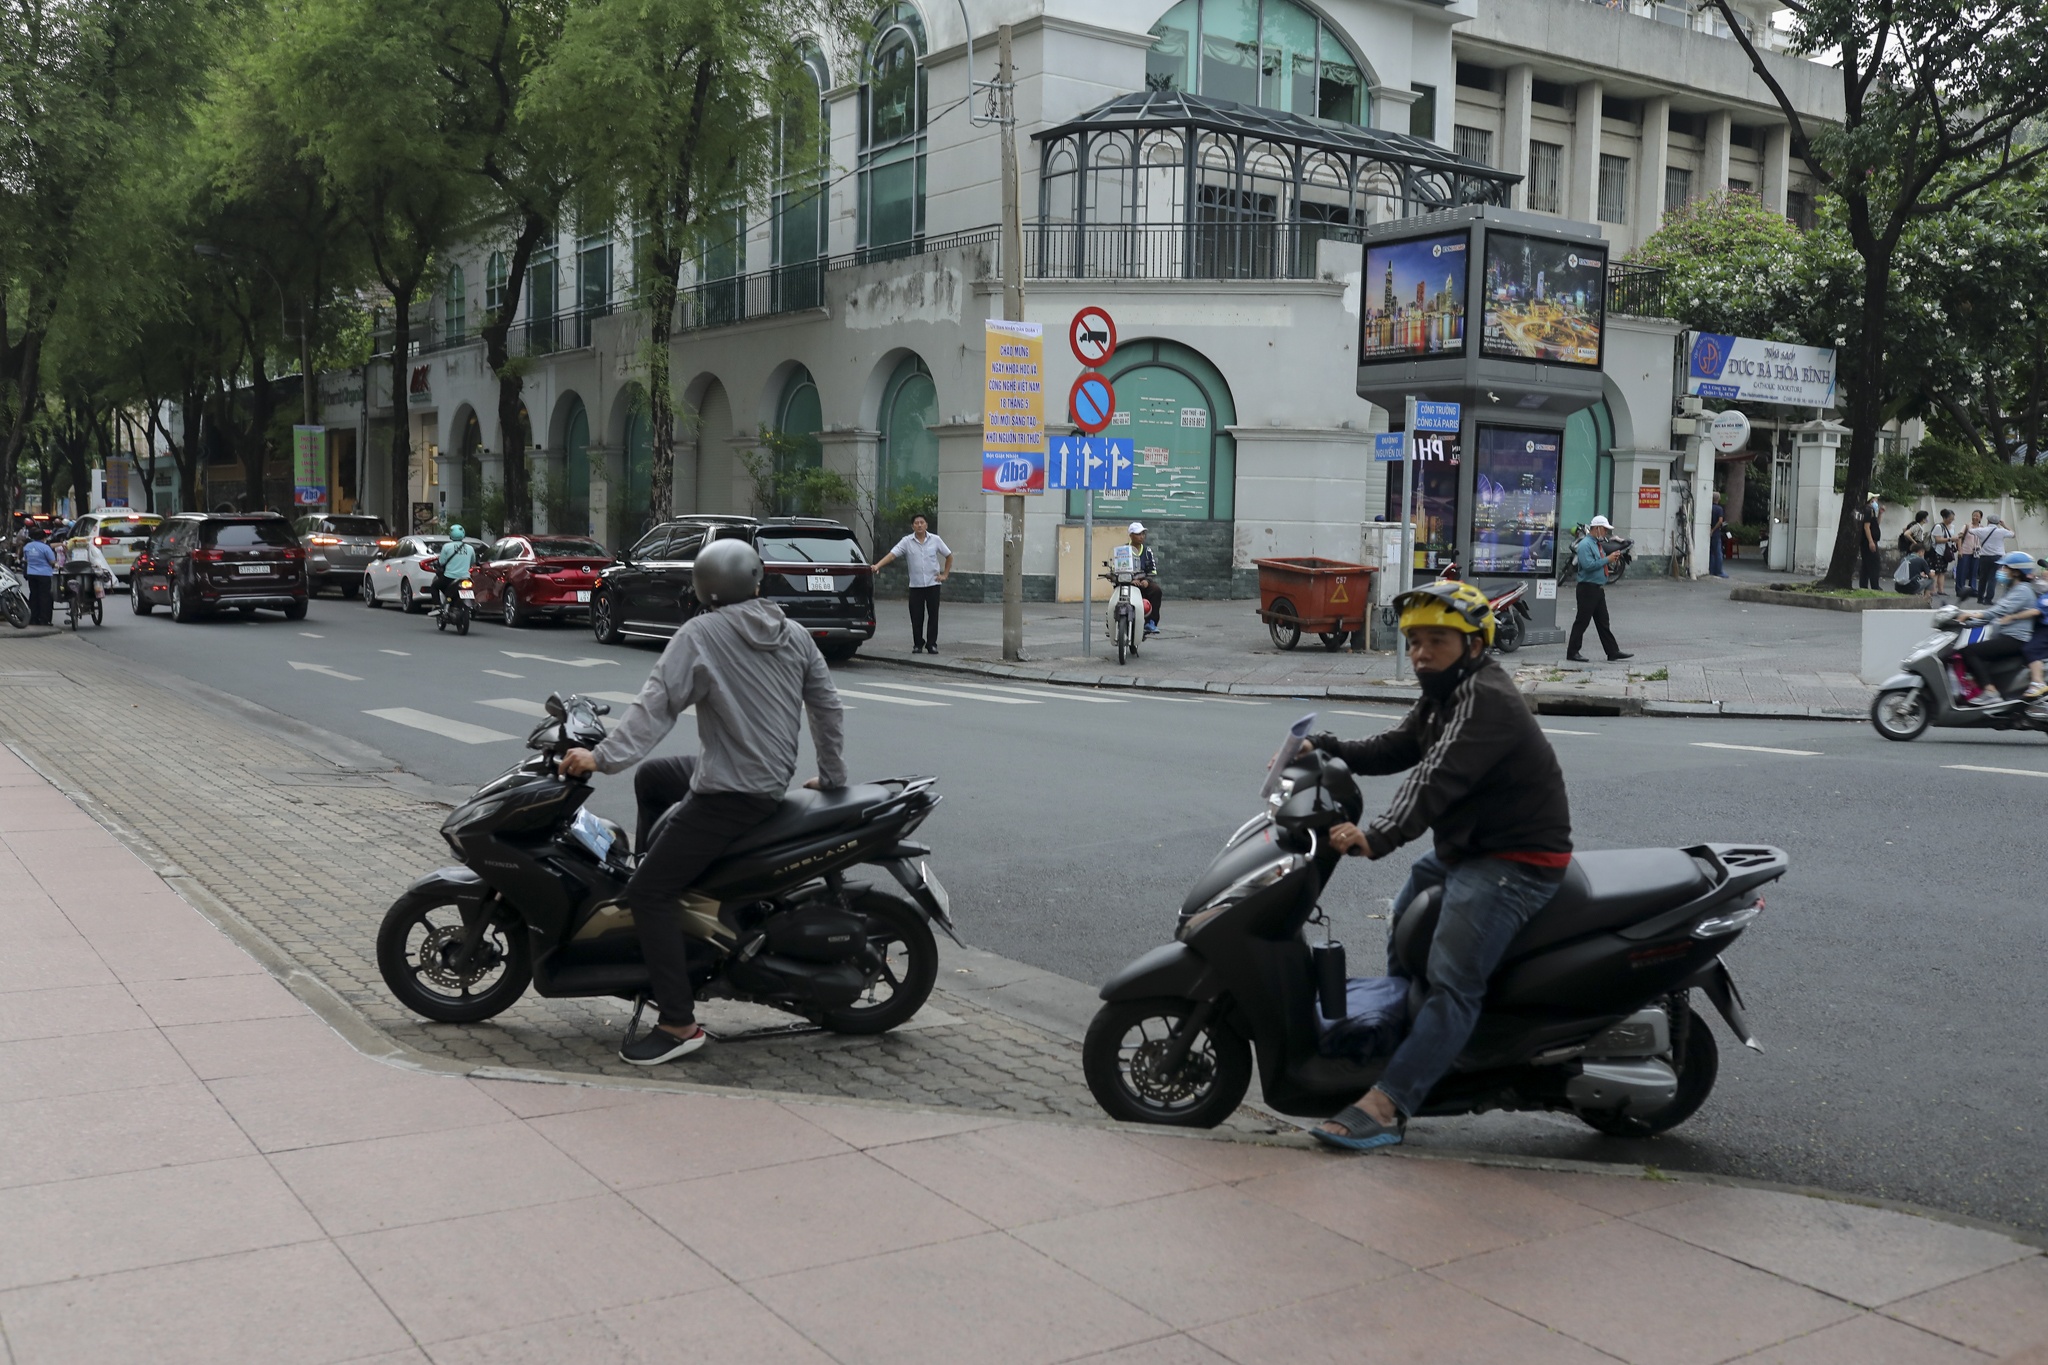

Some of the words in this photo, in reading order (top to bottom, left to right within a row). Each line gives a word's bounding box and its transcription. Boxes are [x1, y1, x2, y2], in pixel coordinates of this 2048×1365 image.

[1006, 363, 1020, 374] KHOA
[1728, 356, 1754, 376] ĐỨC
[1801, 365, 1831, 384] BÌNH
[989, 379, 1002, 391] CÔNG
[1002, 380, 1017, 393] NGHỆ
[1018, 380, 1028, 393] VIỆT
[1029, 382, 1040, 392] NAM
[1000, 398, 1006, 408] 18
[1007, 397, 1024, 409] THÁNG
[1025, 400, 1029, 409] 5
[1421, 403, 1435, 414] CÔNG
[1436, 404, 1456, 415] TRƯỜNG
[1012, 414, 1026, 426] SÁNG
[1027, 416, 1036, 429] TẠO
[1417, 416, 1432, 427] CÔNG
[1442, 420, 1459, 429] PARIS
[1000, 461, 1028, 483] Aba
[484, 860, 520, 870] HONDA
